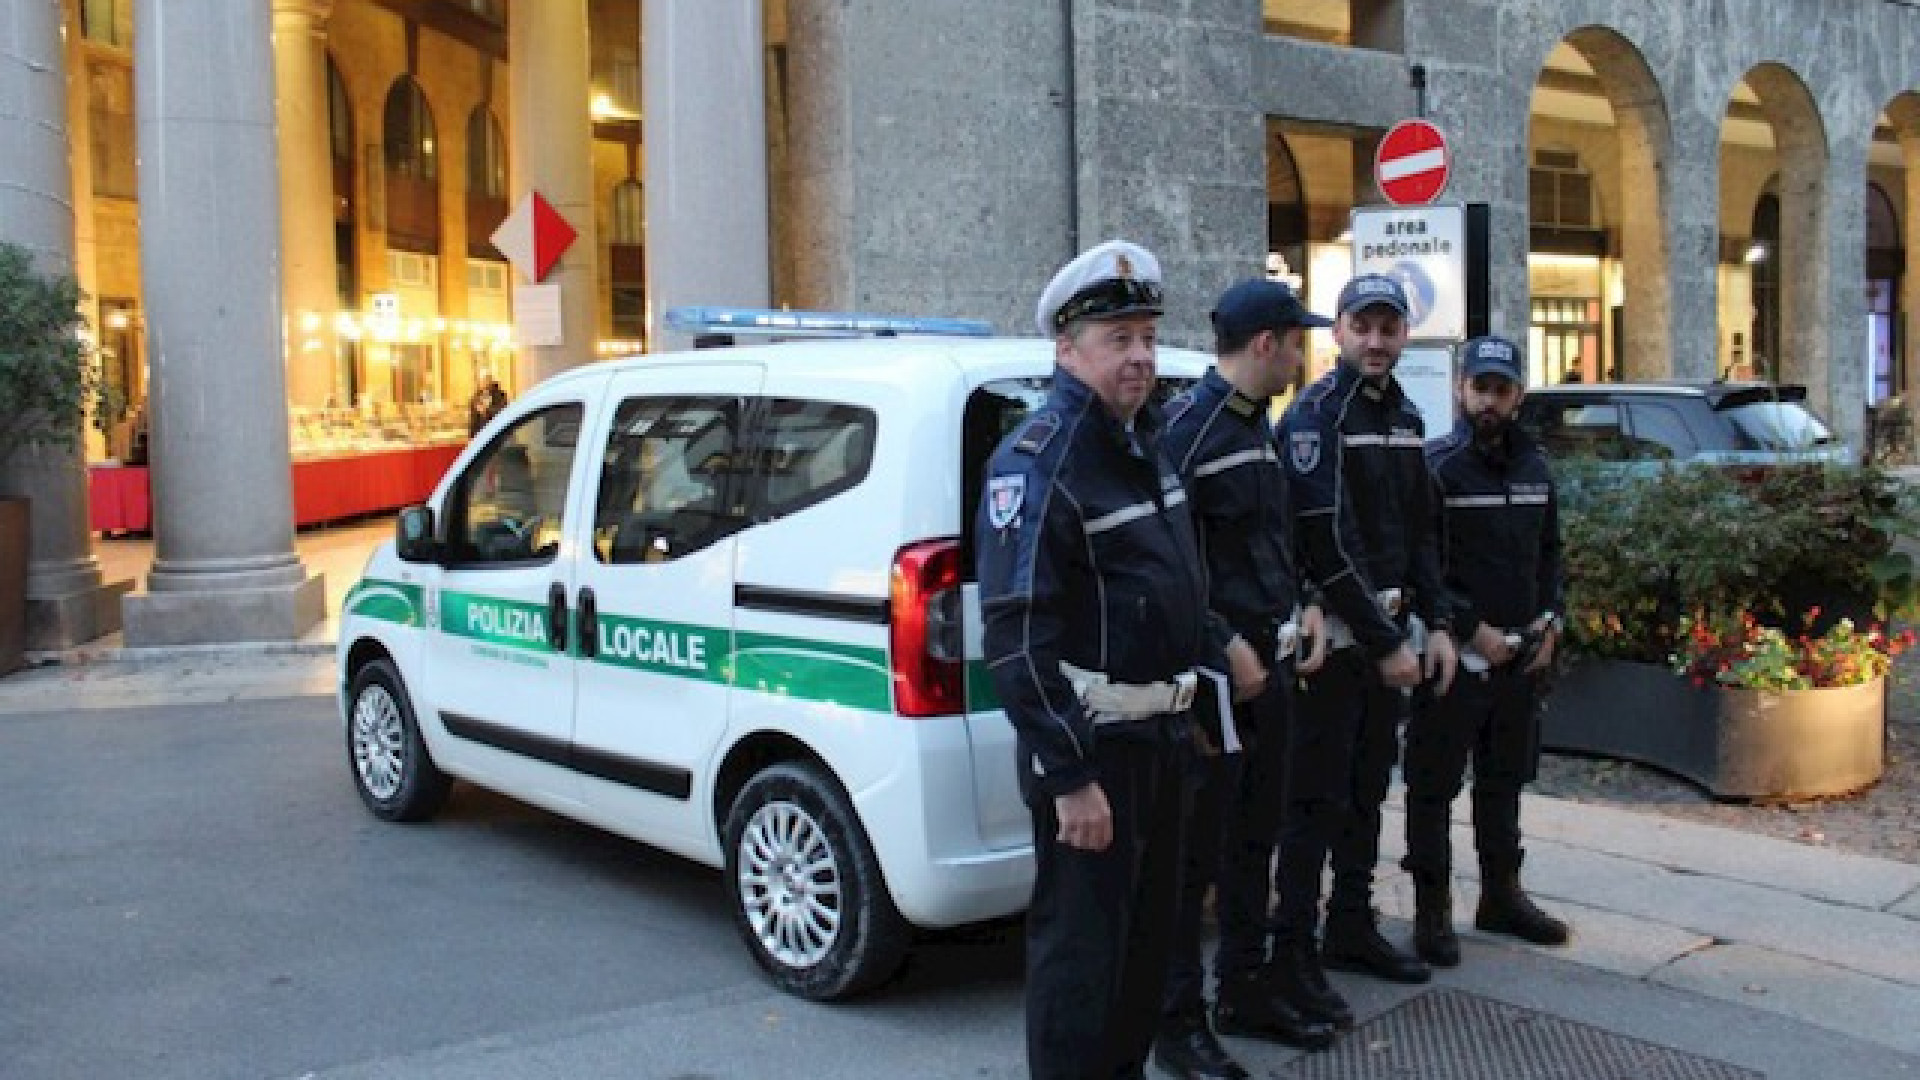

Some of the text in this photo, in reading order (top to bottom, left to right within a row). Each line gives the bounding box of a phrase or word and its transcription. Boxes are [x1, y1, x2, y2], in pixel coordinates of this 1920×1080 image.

[1385, 220, 1427, 235] area
[1363, 237, 1452, 260] pedonale
[467, 603, 547, 642] POLIZIA
[599, 623, 707, 669] LOCALE
